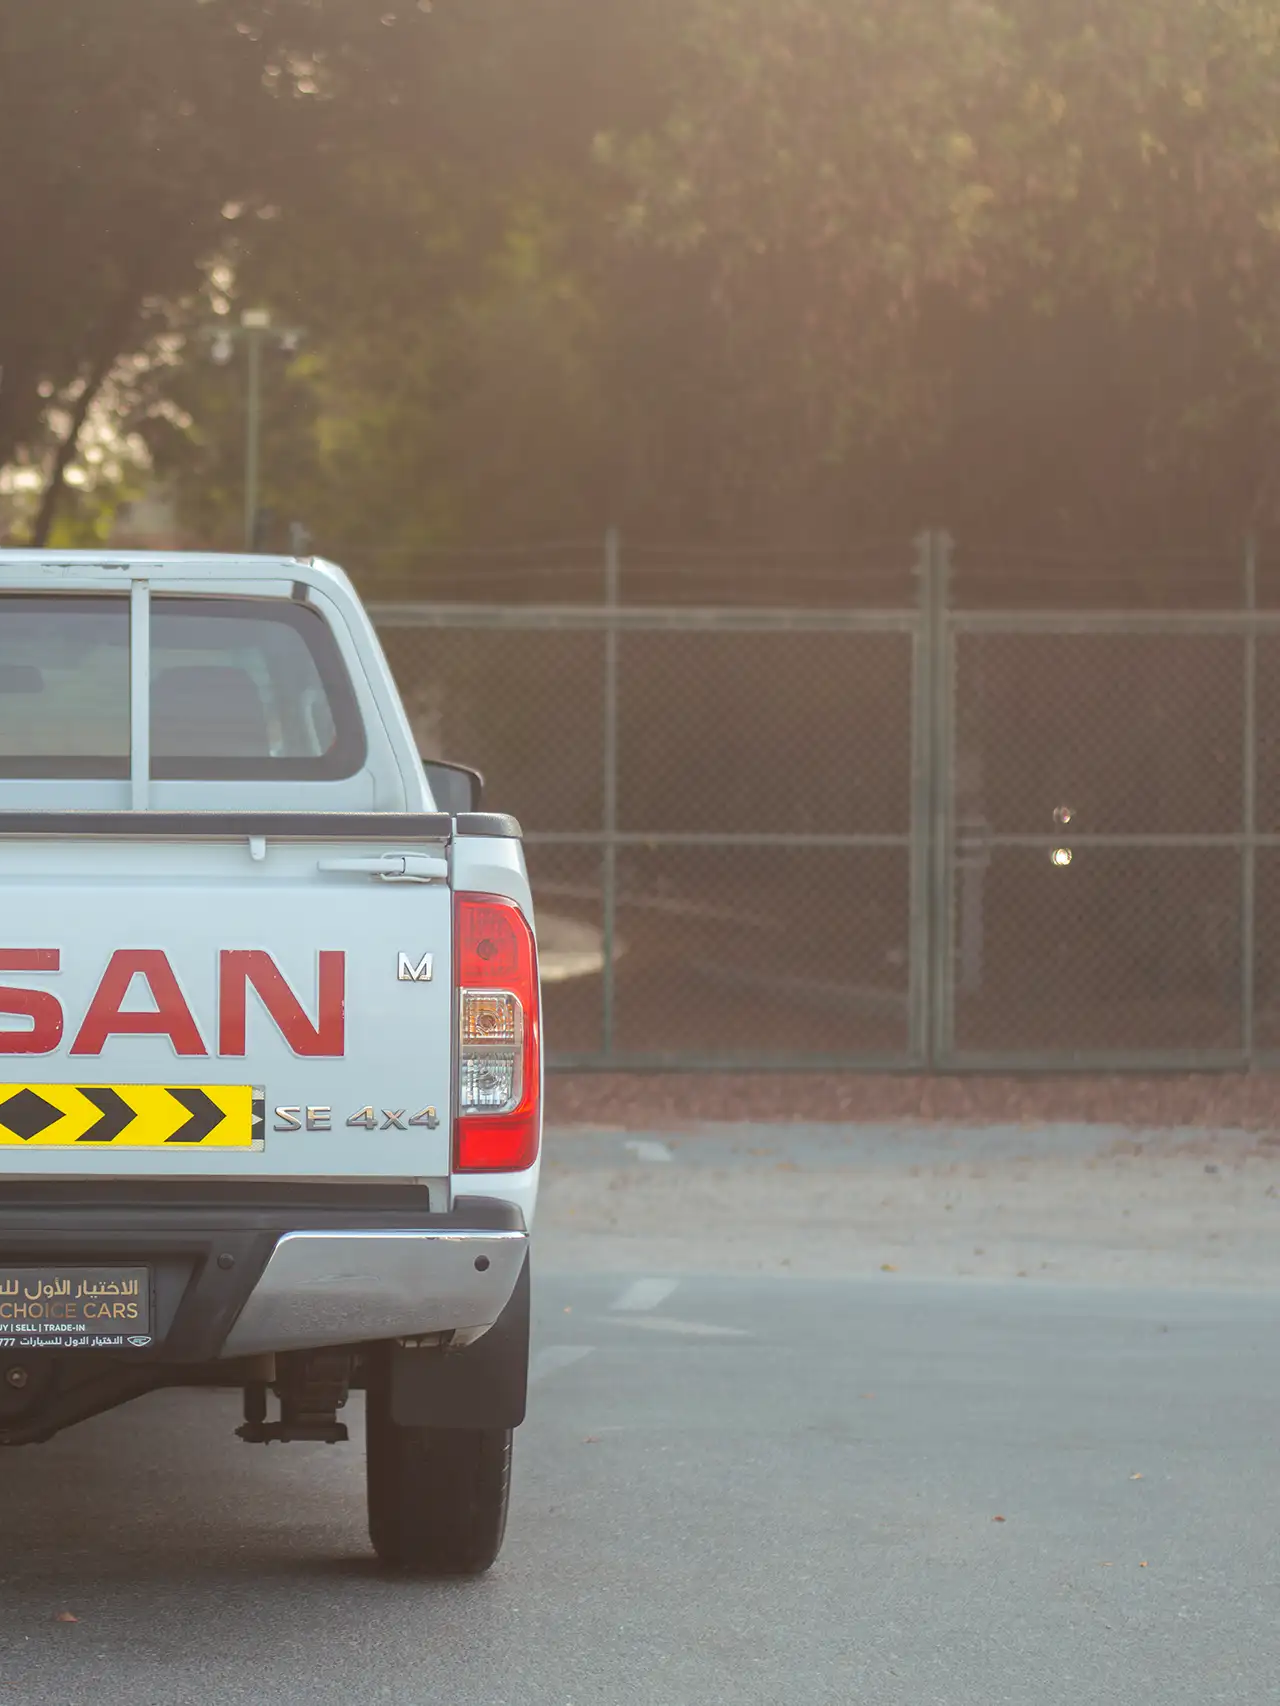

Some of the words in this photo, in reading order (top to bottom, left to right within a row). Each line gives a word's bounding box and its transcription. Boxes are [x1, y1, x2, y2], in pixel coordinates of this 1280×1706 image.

[396, 951, 435, 982] M
[273, 1105, 333, 1132] SE
[24, 1276, 72, 1301] الأول
[74, 1279, 139, 1299] الاختيار
[0, 1302, 77, 1319] CHOICE
[83, 1302, 139, 1319] CARS
[15, 1323, 37, 1332] SELL
[43, 1323, 86, 1332] TRADE-IN
